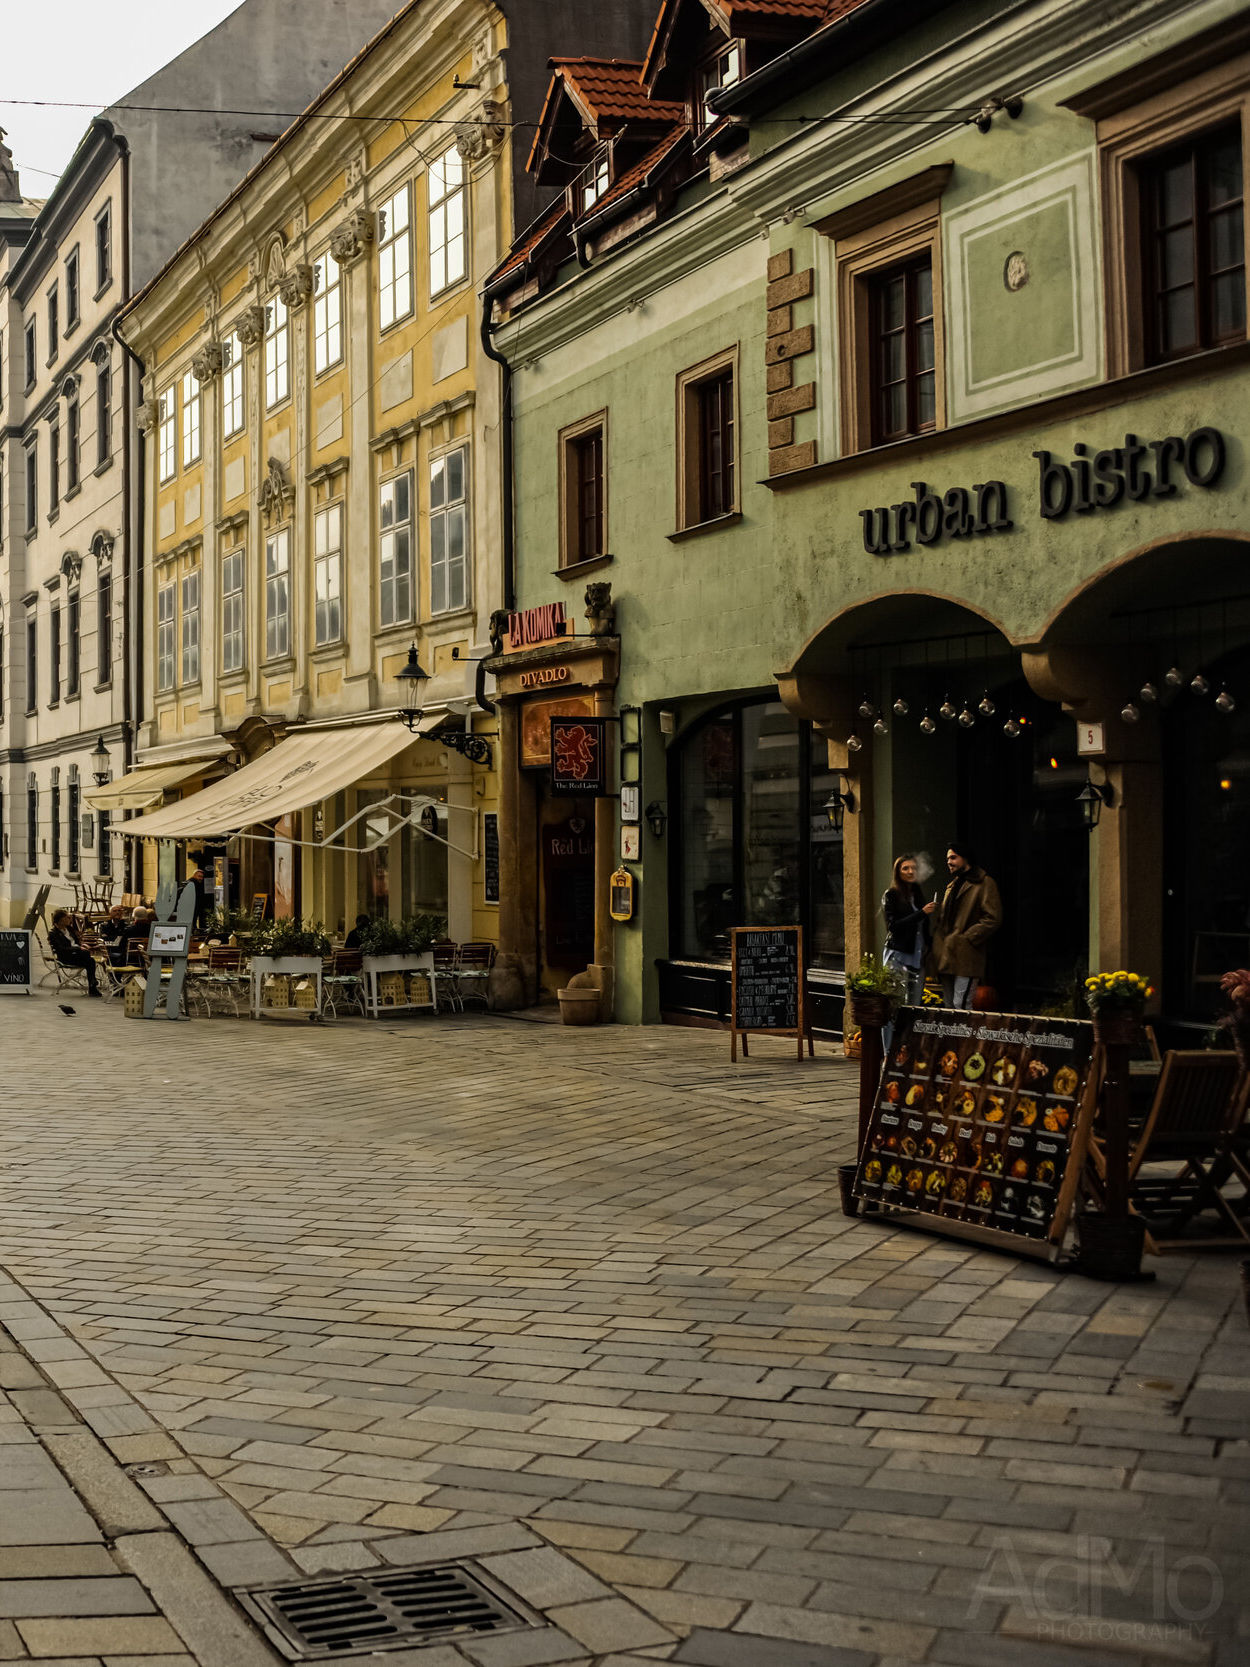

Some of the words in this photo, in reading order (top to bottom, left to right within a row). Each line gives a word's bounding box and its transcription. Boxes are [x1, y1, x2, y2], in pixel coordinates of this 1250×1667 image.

[859, 481, 1012, 554] urban
[1032, 426, 1227, 520] bistro
[508, 612, 522, 648] LA
[519, 667, 567, 687] DIVADLO
[1086, 729, 1094, 745] 5
[551, 838, 574, 855] Red
[578, 838, 594, 855] Li
